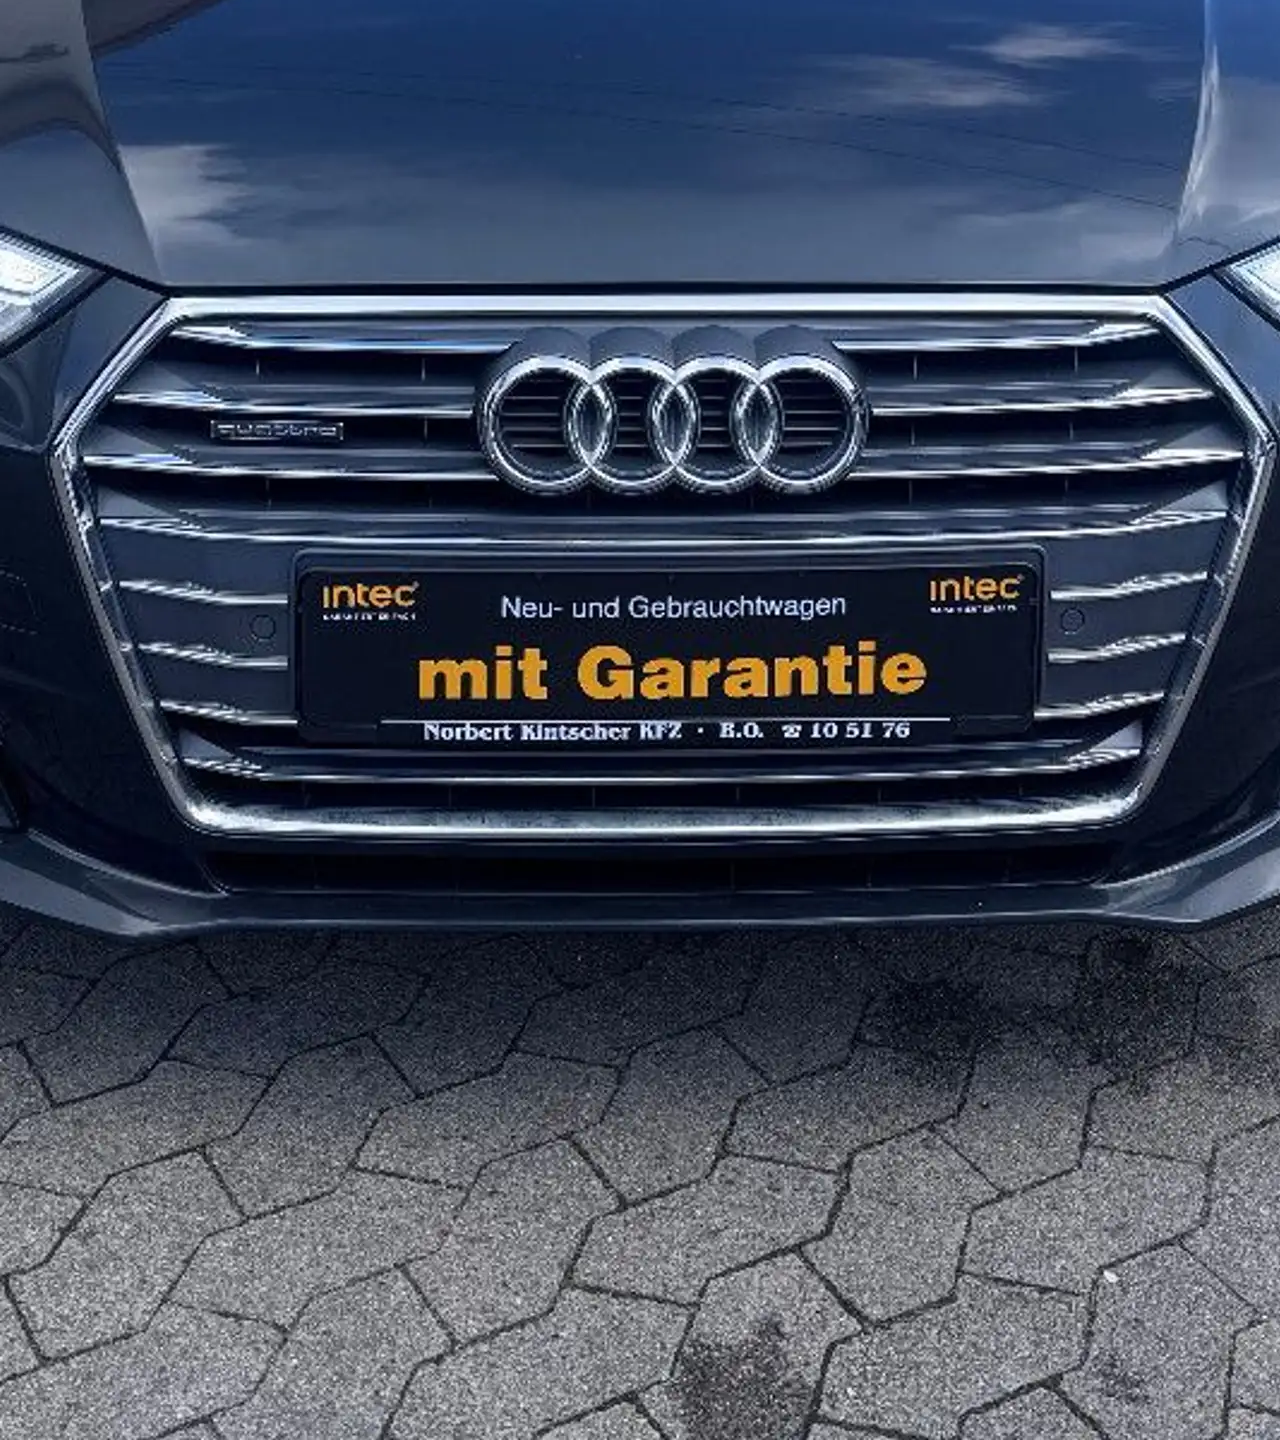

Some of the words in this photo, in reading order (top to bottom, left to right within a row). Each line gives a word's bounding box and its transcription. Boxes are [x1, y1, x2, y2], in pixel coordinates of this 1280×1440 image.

[500, 595, 563, 619] Neu-
[572, 595, 620, 619] und
[627, 594, 846, 621] Gebrauchtwagen
[418, 645, 548, 700] mit
[577, 640, 928, 700] Garantie
[423, 722, 515, 741] Norbert
[519, 722, 632, 741] Kintscher
[639, 722, 683, 740] KFZ
[810, 722, 839, 739] 10
[844, 722, 873, 739] 51
[882, 722, 911, 739] 76
